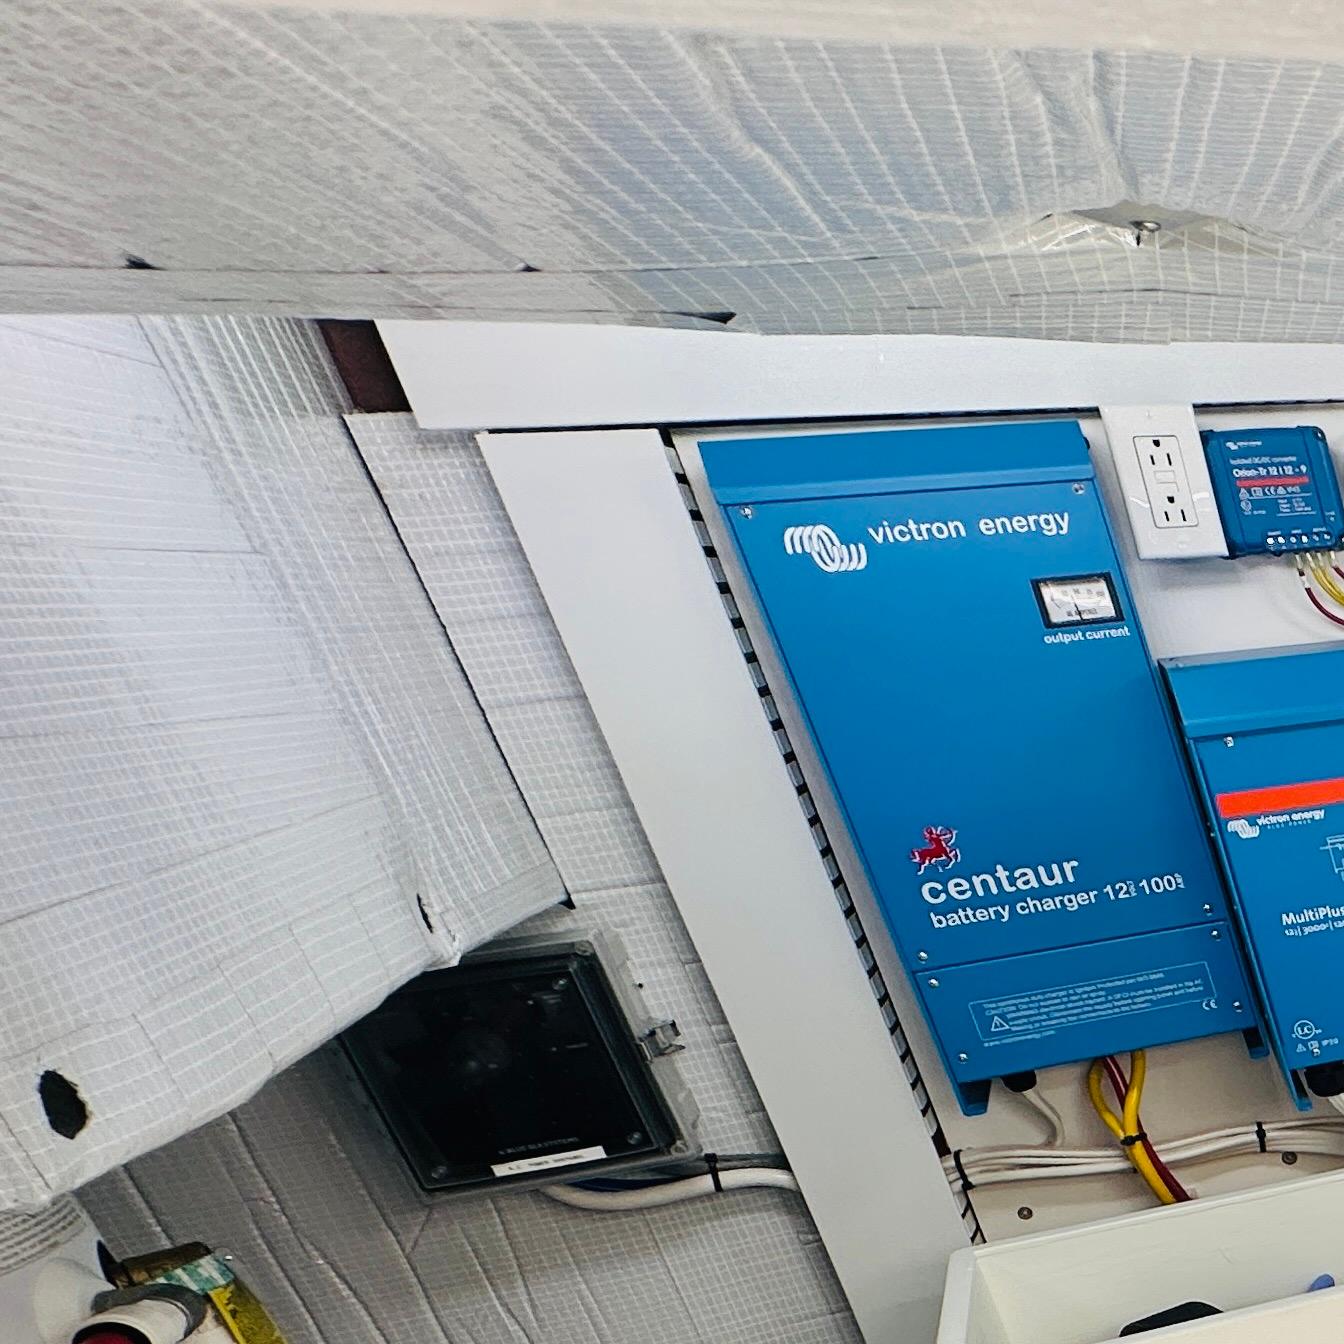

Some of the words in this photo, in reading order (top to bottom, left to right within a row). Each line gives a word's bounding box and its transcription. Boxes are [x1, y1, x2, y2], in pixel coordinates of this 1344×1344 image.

[868, 519, 966, 545] victron
[979, 511, 1070, 538] energy
[1044, 630, 1085, 645] output
[1086, 625, 1131, 640] current
[1256, 814, 1290, 827] victron
[1291, 809, 1325, 821] energy
[921, 857, 1080, 906] centaur
[929, 904, 1012, 930] battery
[1016, 888, 1099, 917] charger
